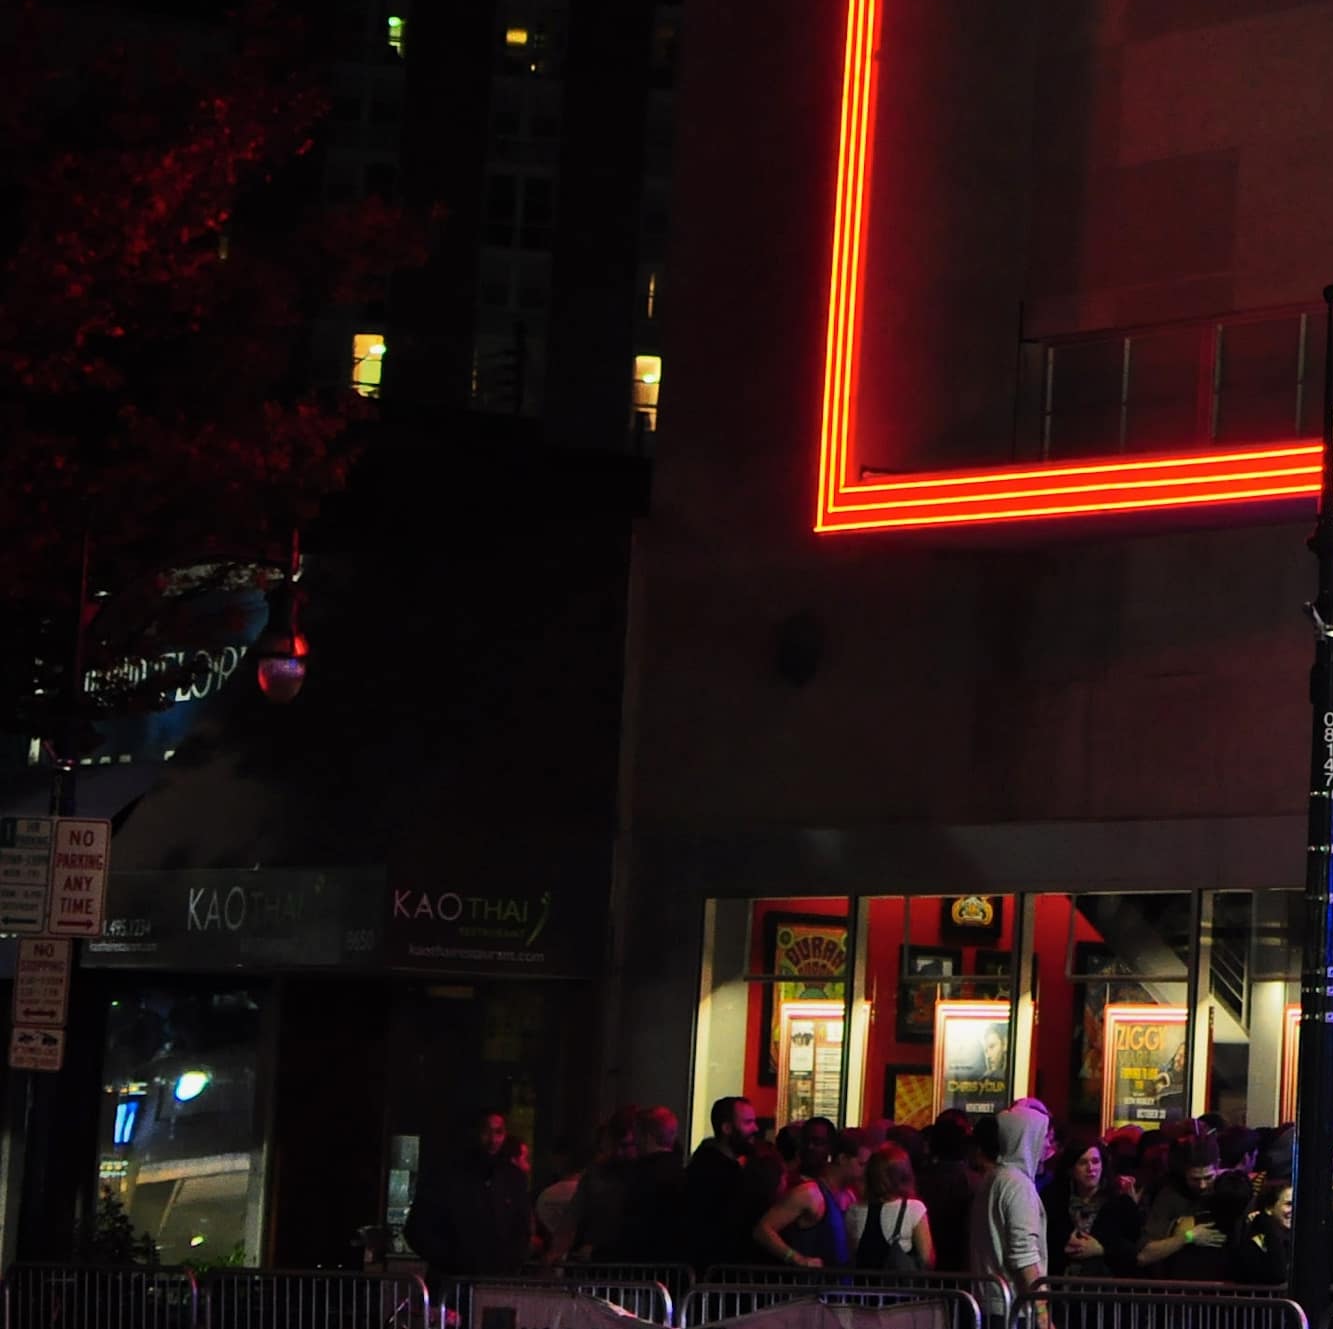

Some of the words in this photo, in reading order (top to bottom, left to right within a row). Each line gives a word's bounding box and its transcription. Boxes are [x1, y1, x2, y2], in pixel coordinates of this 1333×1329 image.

[70, 831, 94, 847] NO
[56, 854, 103, 871] PARKING
[64, 876, 92, 892] ANY
[60, 897, 94, 914] TIME
[34, 943, 54, 958] NO
[1116, 1023, 1168, 1051] ZIGGY
